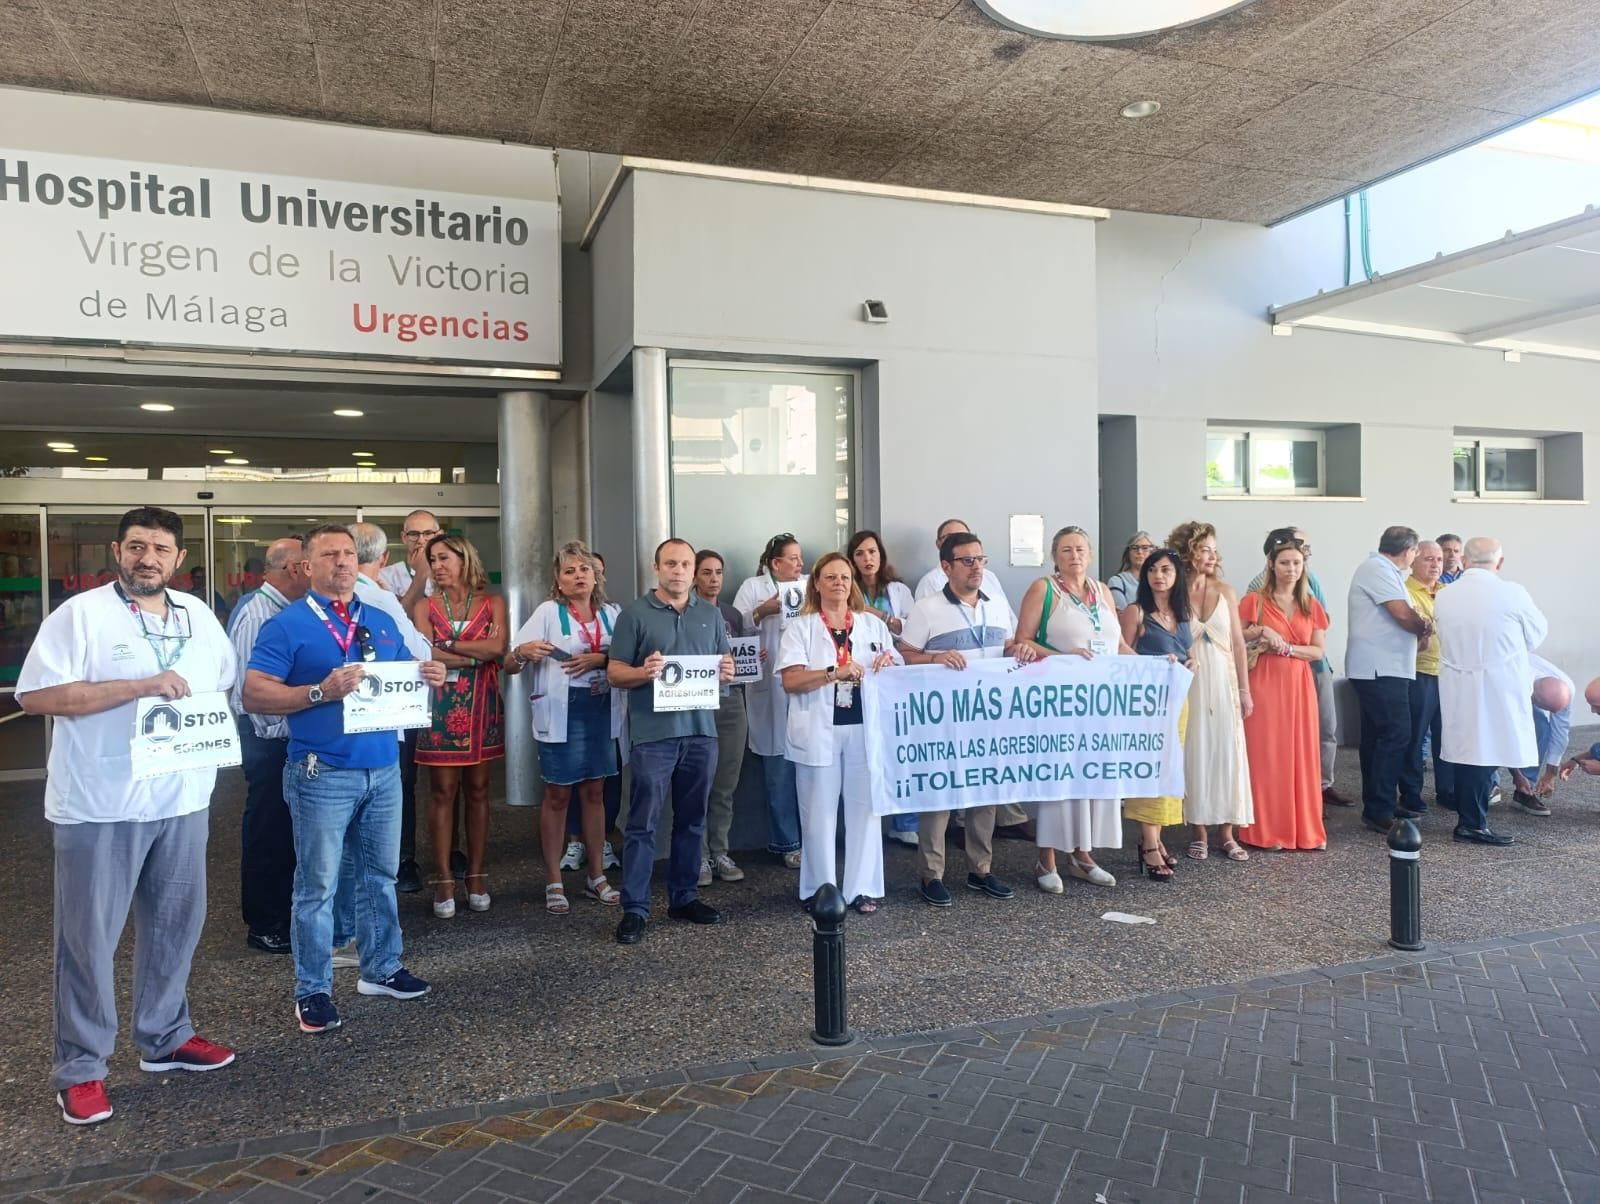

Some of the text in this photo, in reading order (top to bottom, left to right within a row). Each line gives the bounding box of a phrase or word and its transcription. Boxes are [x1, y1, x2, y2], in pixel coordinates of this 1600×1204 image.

[0, 159, 529, 246] Hospital Universitario
[77, 230, 529, 295] Virgen de la Victoria
[79, 290, 529, 343] de Málaga Urgencias
[384, 680, 424, 693] STOP
[685, 669, 716, 679] STOP
[184, 711, 228, 728] STOP
[895, 680, 1169, 736] ¡¡NO MÁS AGRESIONES!!
[897, 741, 956, 764] CONTRA
[960, 738, 986, 758] LAS
[989, 733, 1075, 757] AGRESIONES
[1078, 733, 1088, 751] A
[896, 763, 1075, 798] ¡¡TOLERANCIA
